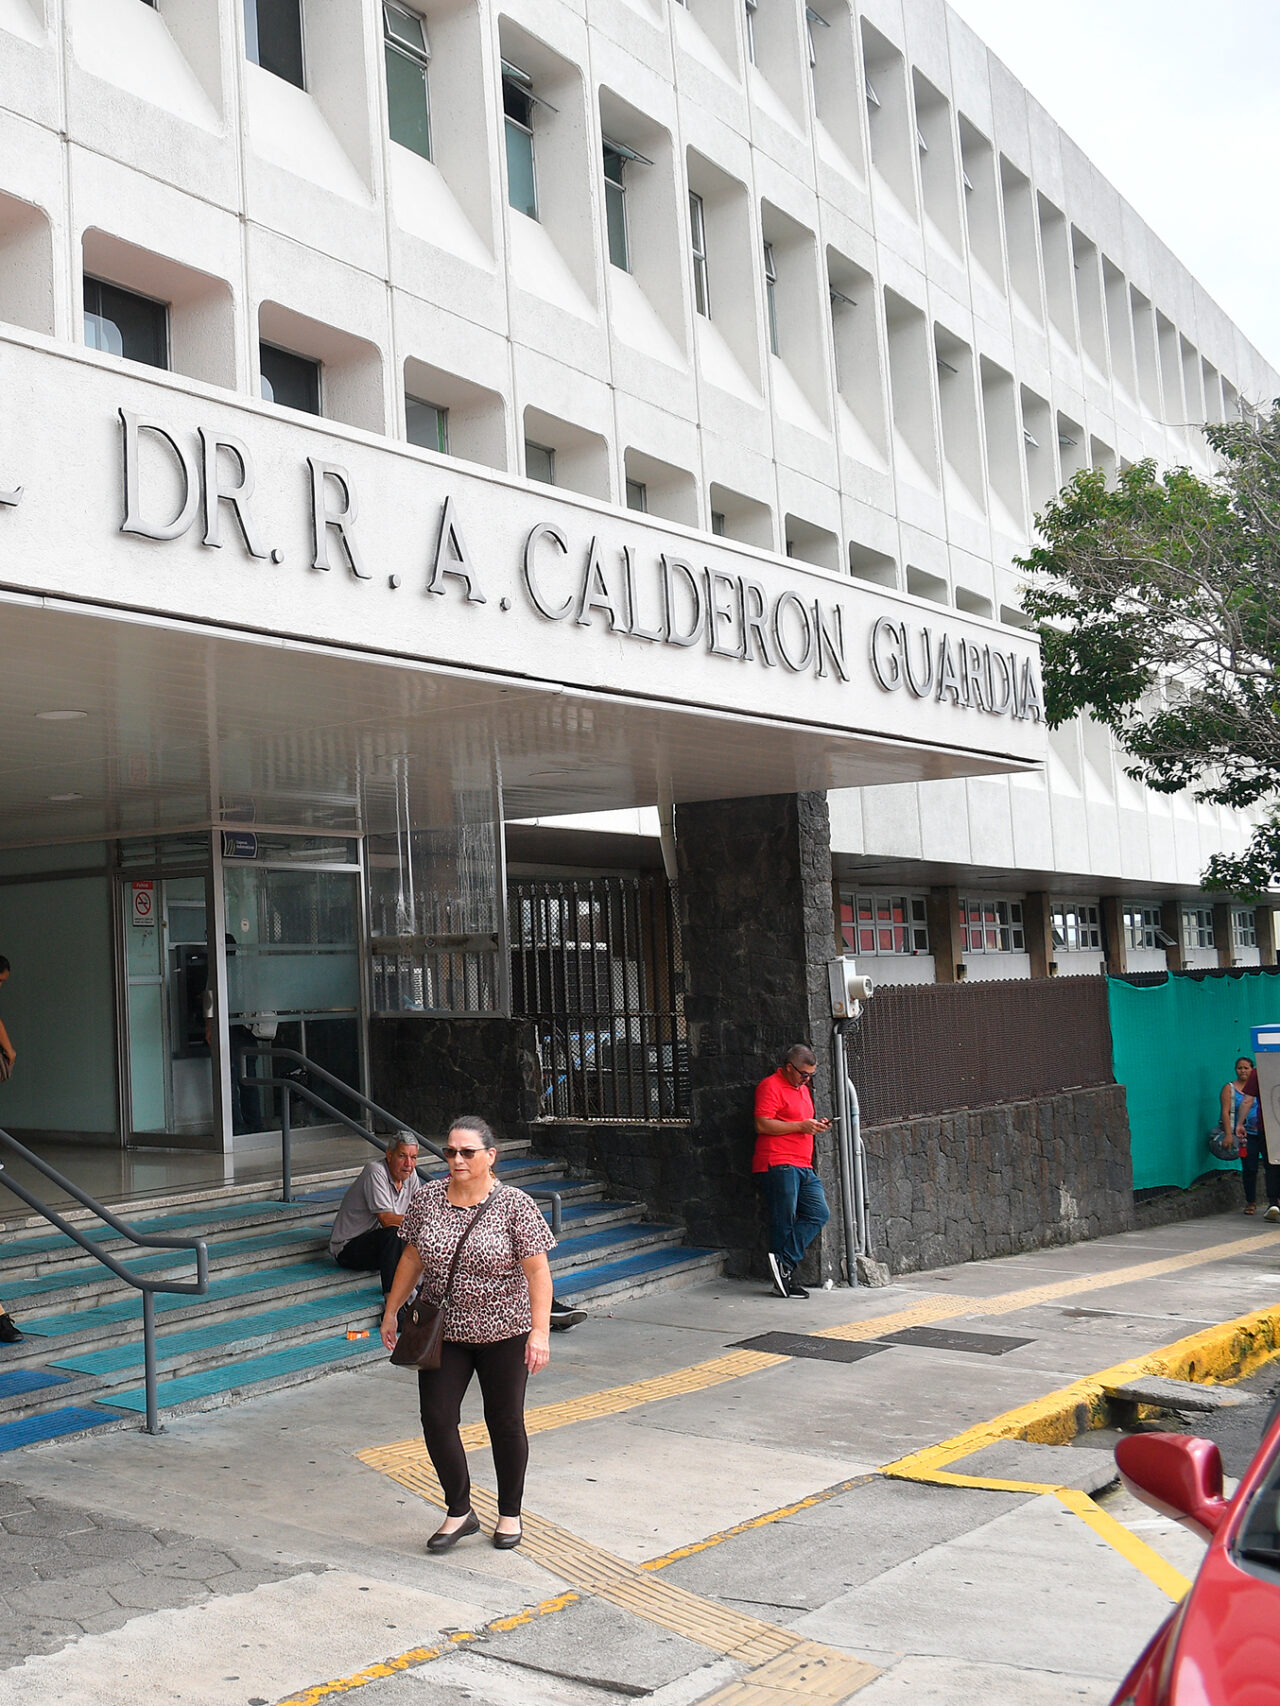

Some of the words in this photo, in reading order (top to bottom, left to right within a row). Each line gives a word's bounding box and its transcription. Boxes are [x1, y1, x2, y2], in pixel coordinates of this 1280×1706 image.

[118, 407, 285, 564] DR.
[427, 495, 512, 612] A.
[522, 521, 851, 682] CALDERON
[872, 615, 1048, 724] GUARDIA
